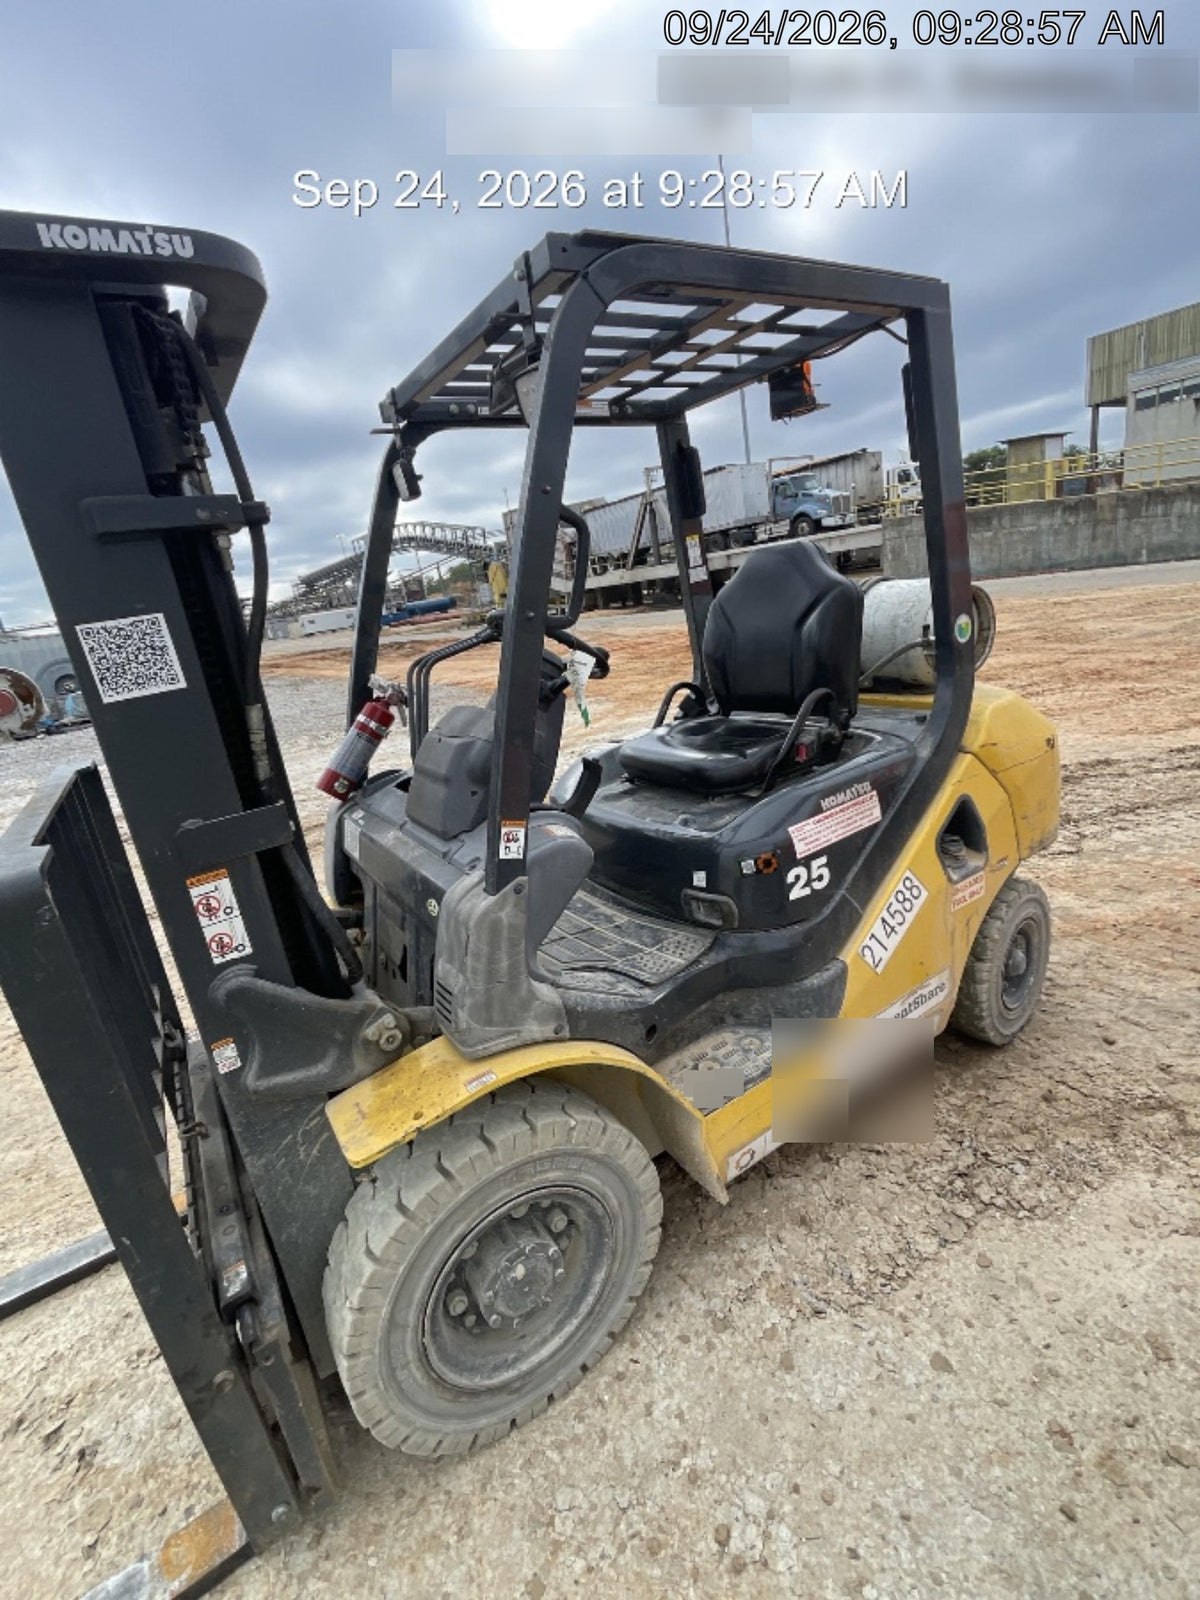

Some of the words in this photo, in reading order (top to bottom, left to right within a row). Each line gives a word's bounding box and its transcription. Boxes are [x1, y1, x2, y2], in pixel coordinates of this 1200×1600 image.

[36, 223, 195, 259] KOMATSU
[820, 781, 872, 812] KOMATSU
[786, 855, 831, 901] 25
[861, 875, 922, 969] 214588
